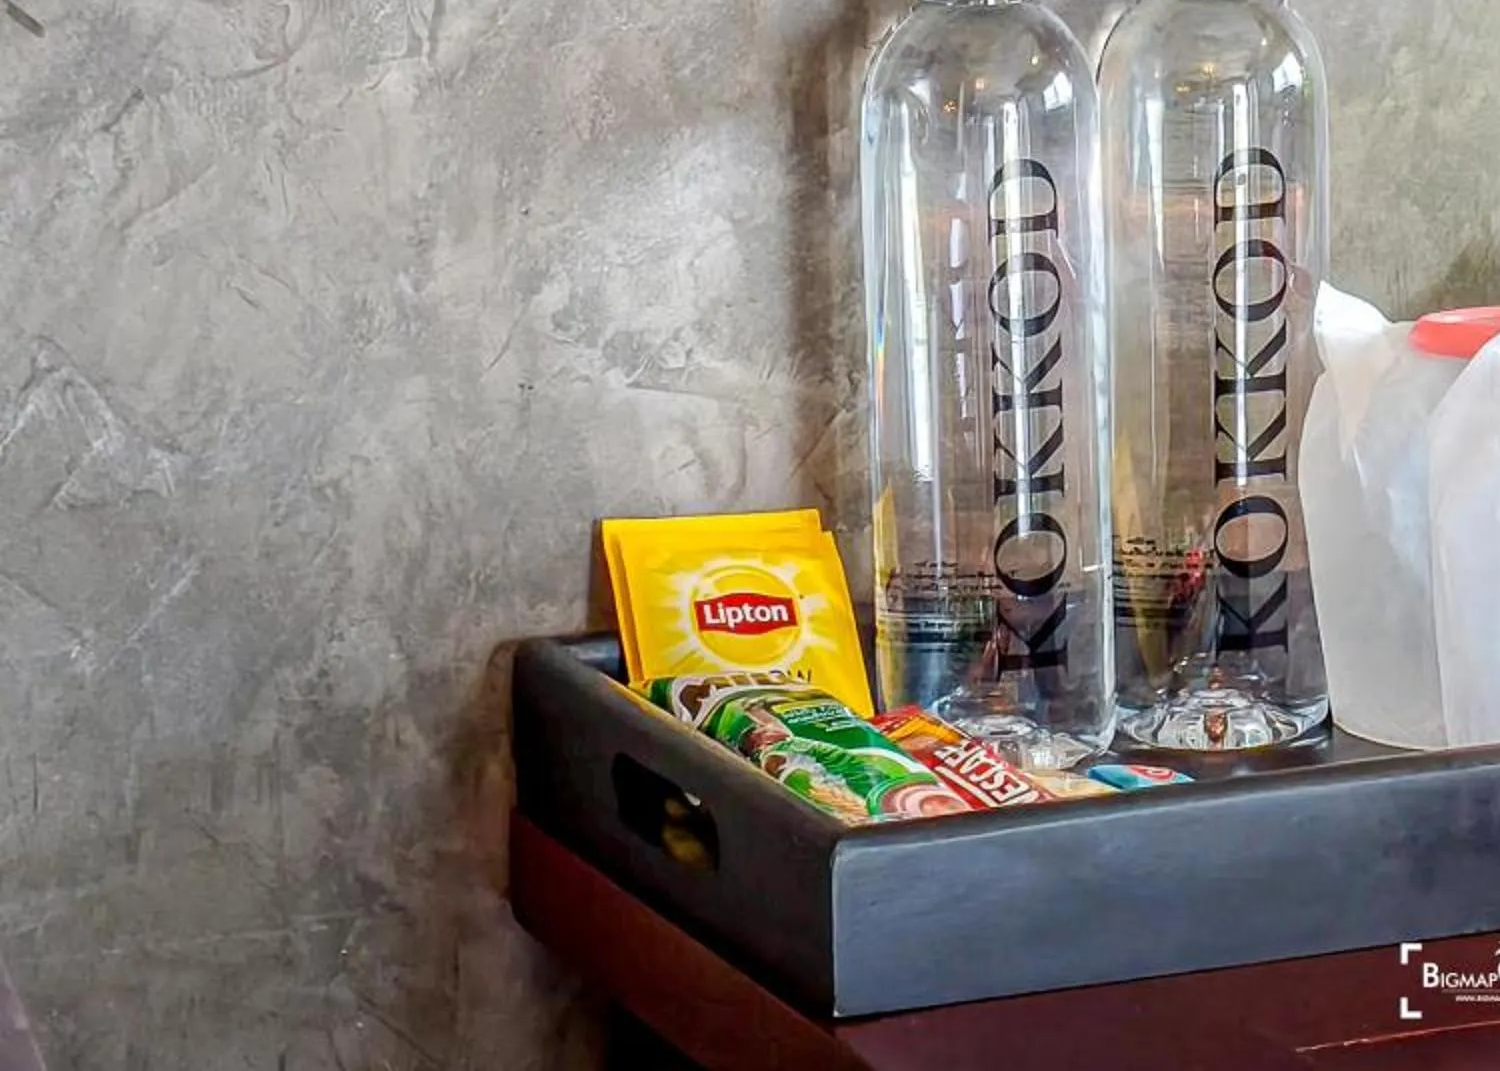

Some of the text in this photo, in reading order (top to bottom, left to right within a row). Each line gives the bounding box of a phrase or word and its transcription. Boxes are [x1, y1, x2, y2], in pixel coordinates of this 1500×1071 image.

[703, 602, 789, 628] Lipton
[988, 158, 1068, 680] KOKKOD
[1212, 146, 1290, 653] KOKKOD
